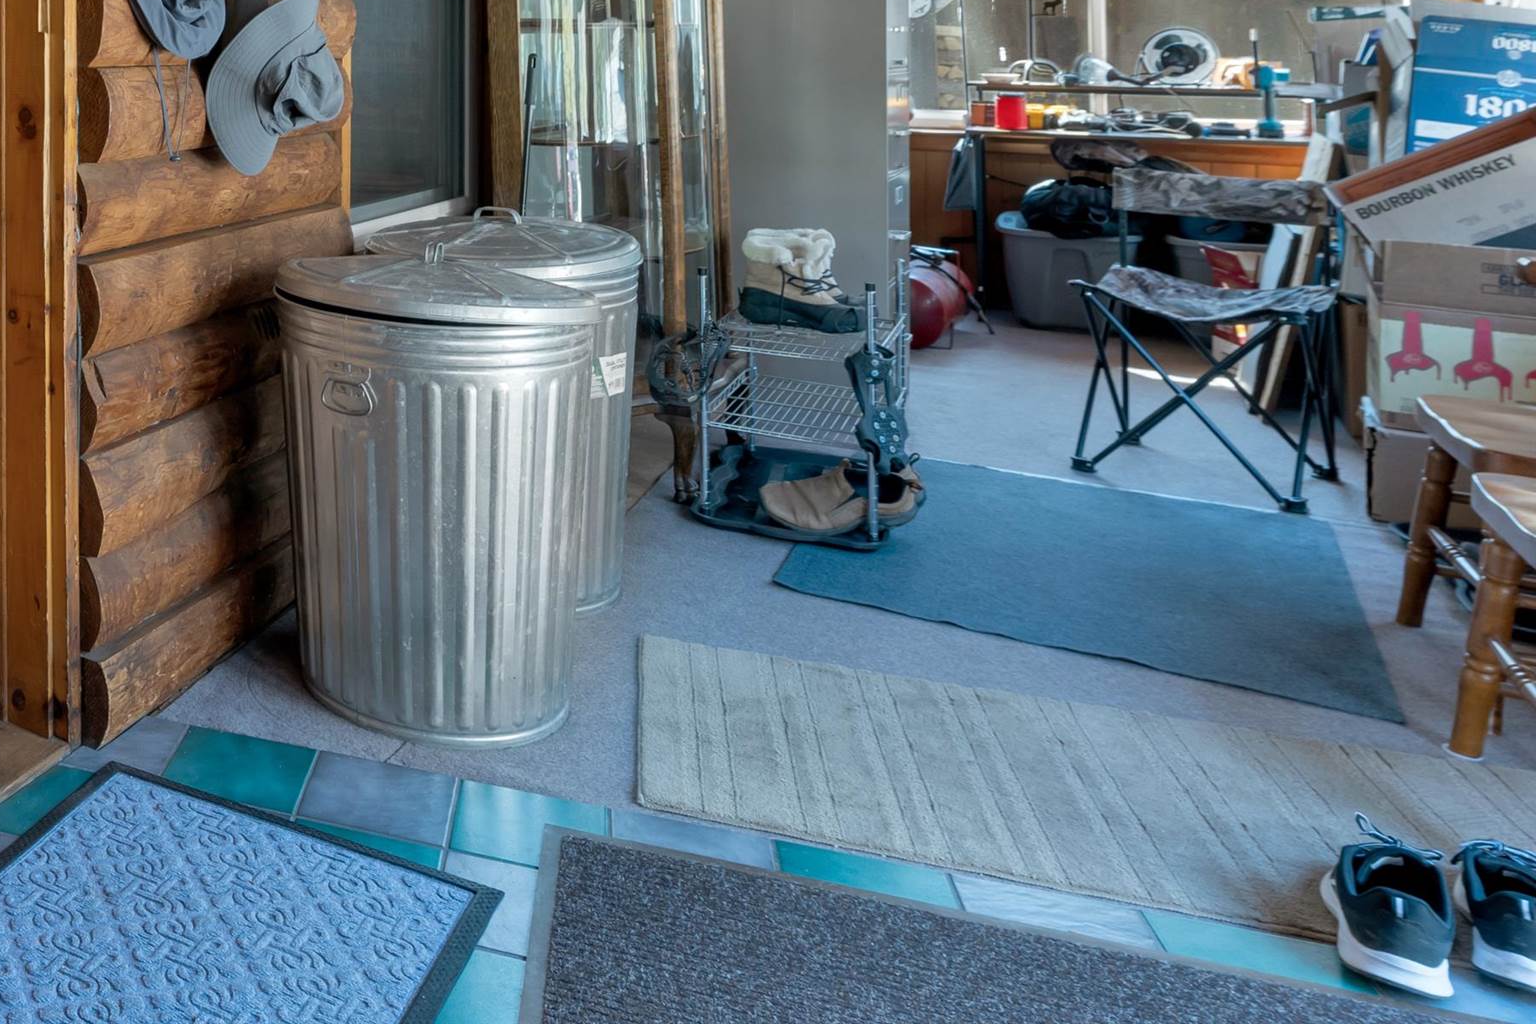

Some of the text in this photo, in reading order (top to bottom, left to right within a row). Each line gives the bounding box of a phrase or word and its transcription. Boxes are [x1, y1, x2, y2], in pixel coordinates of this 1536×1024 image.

[1464, 93, 1536, 119] 180
[1355, 154, 1517, 221] BOURBON WHISKEY
